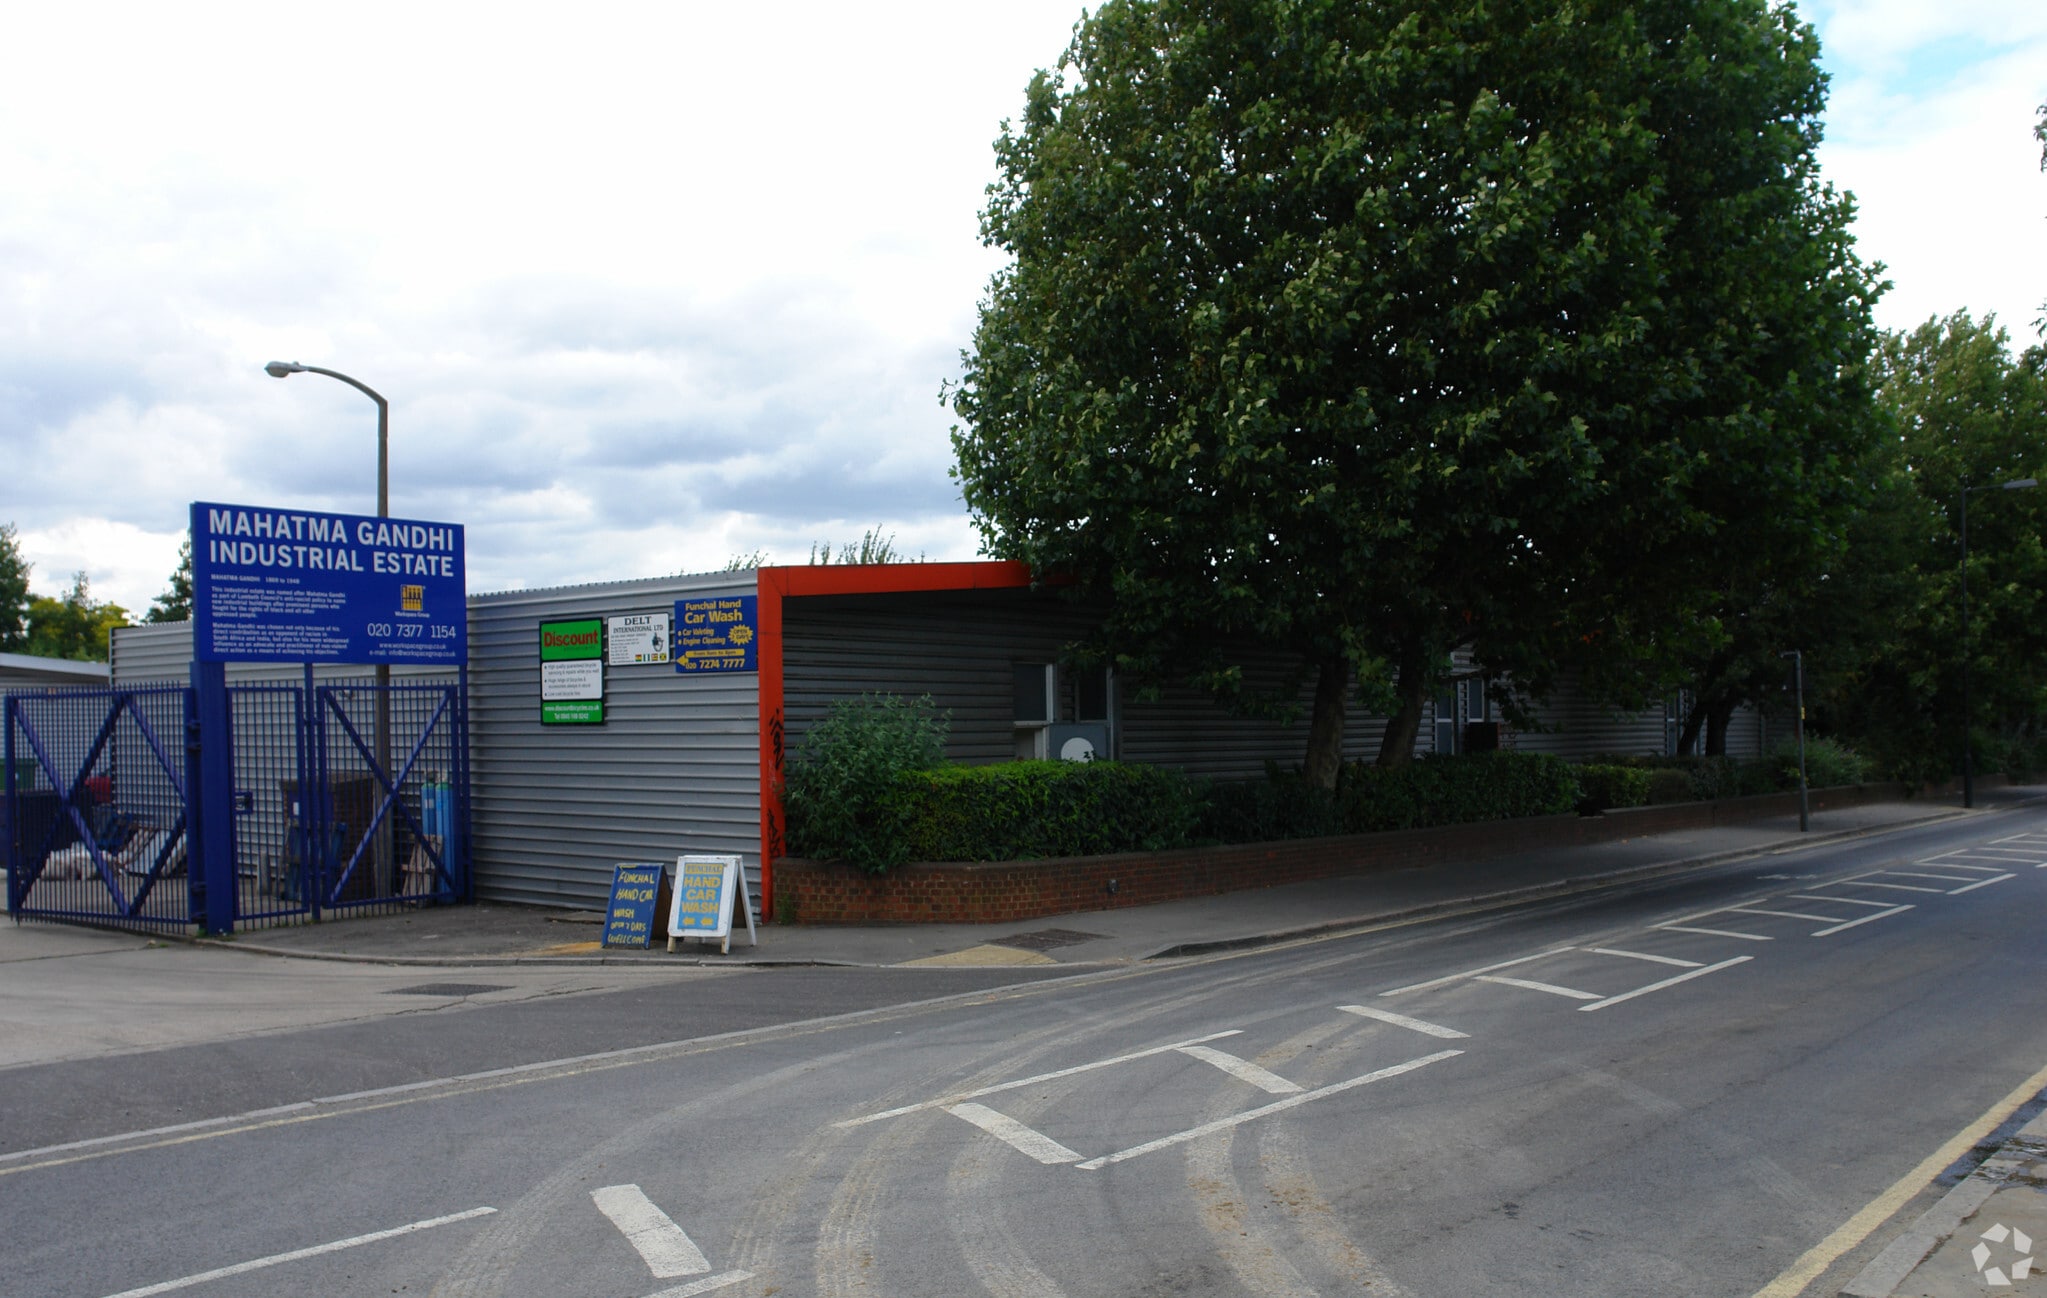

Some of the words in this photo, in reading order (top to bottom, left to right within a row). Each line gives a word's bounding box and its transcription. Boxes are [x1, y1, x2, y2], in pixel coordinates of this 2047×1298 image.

[209, 507, 348, 544] MAHATMA
[357, 520, 453, 552] GANDHI
[209, 539, 364, 572] INDUSTRIAL
[373, 551, 454, 578] ESTATE
[685, 601, 717, 611] Funchal
[719, 599, 742, 609] Hand
[624, 616, 652, 626] DELT
[685, 611, 705, 624] Car
[708, 608, 743, 623] Wash
[367, 622, 391, 637] 020
[396, 623, 424, 638] 7377
[430, 624, 457, 639] 1154
[613, 625, 652, 634] INTERNATIONAL
[692, 628, 714, 637] Valeting
[543, 629, 598, 648] Discount
[683, 638, 701, 646] Engine
[702, 637, 726, 645] Cleaning
[699, 659, 720, 669] 7274
[723, 658, 745, 668] 7777
[687, 865, 722, 873] FUNCHAL
[617, 871, 655, 884] FUNCHAL
[683, 877, 721, 888] HAND
[615, 888, 639, 901] HAND
[639, 889, 654, 902] CAR
[685, 889, 716, 900] CAR
[682, 901, 719, 913] WASH
[613, 909, 635, 918] WASH
[630, 921, 646, 932] DAYS
